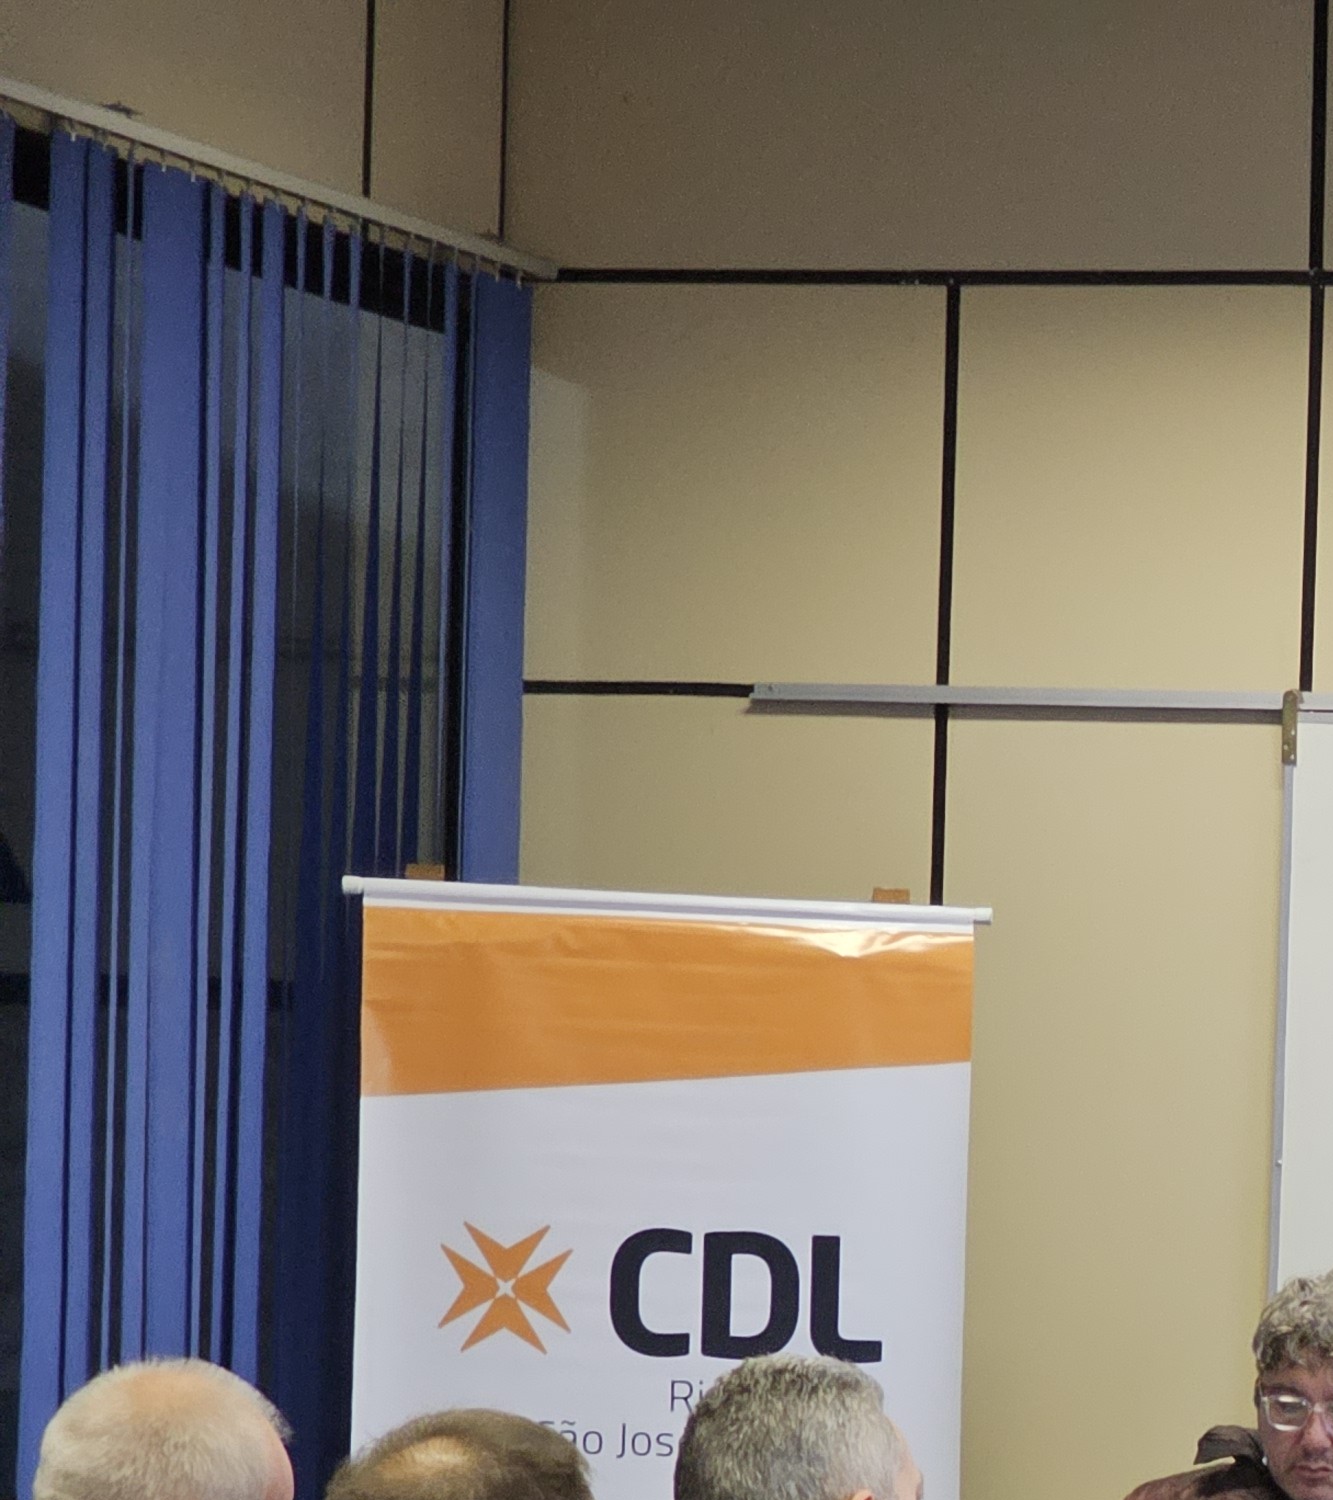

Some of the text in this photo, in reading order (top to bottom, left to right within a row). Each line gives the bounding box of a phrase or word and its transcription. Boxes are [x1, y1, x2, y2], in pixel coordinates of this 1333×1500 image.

[609, 1227, 883, 1364] CDL
[670, 1379, 705, 1414] Ri
[616, 1422, 674, 1459] Jos
